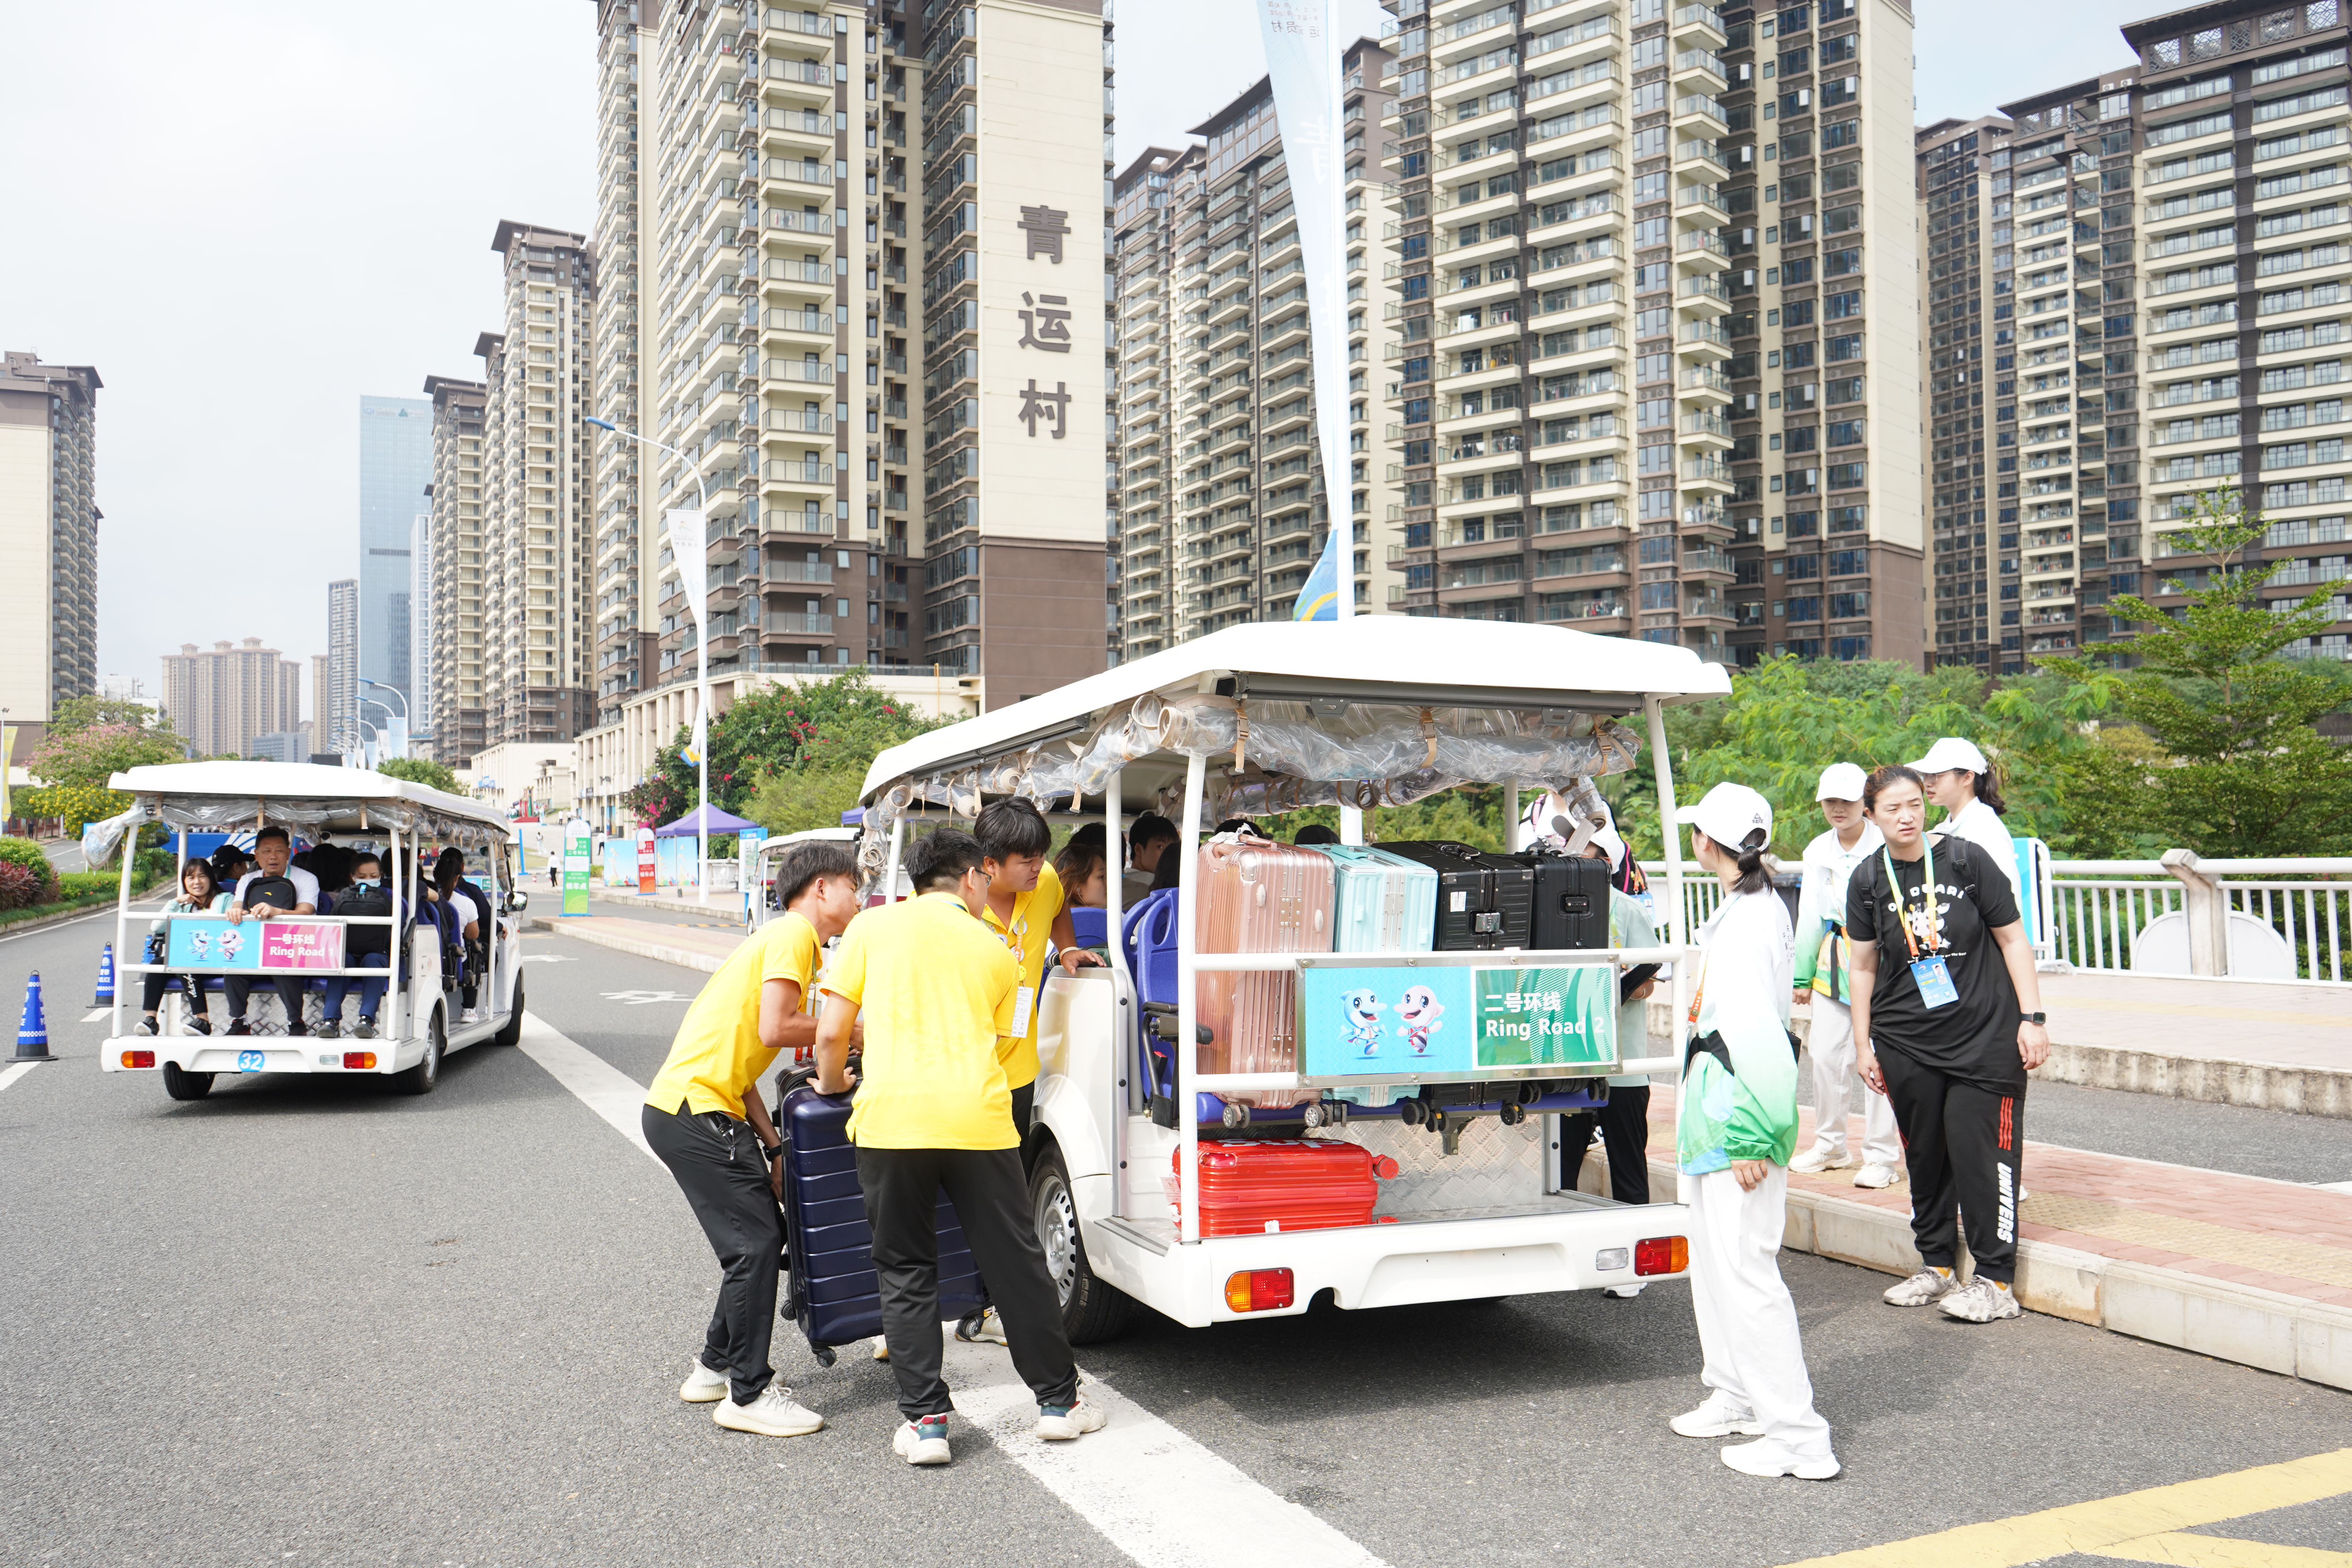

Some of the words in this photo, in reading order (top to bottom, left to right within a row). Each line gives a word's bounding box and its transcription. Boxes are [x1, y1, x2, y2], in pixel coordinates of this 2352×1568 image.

[1018, 205, 1071, 439] 青运村
[270, 933, 315, 945] 一号环线
[270, 946, 294, 958] Ring
[298, 947, 325, 956] Road
[328, 947, 334, 956] 1
[1485, 991, 1561, 1013] 二号环线
[1486, 1019, 1530, 1041] Ring
[1538, 1016, 1586, 1035] Road
[1594, 1016, 1604, 1033] 2
[240, 1053, 262, 1070] 32
[1997, 1162, 2014, 1243] UNIVERS
